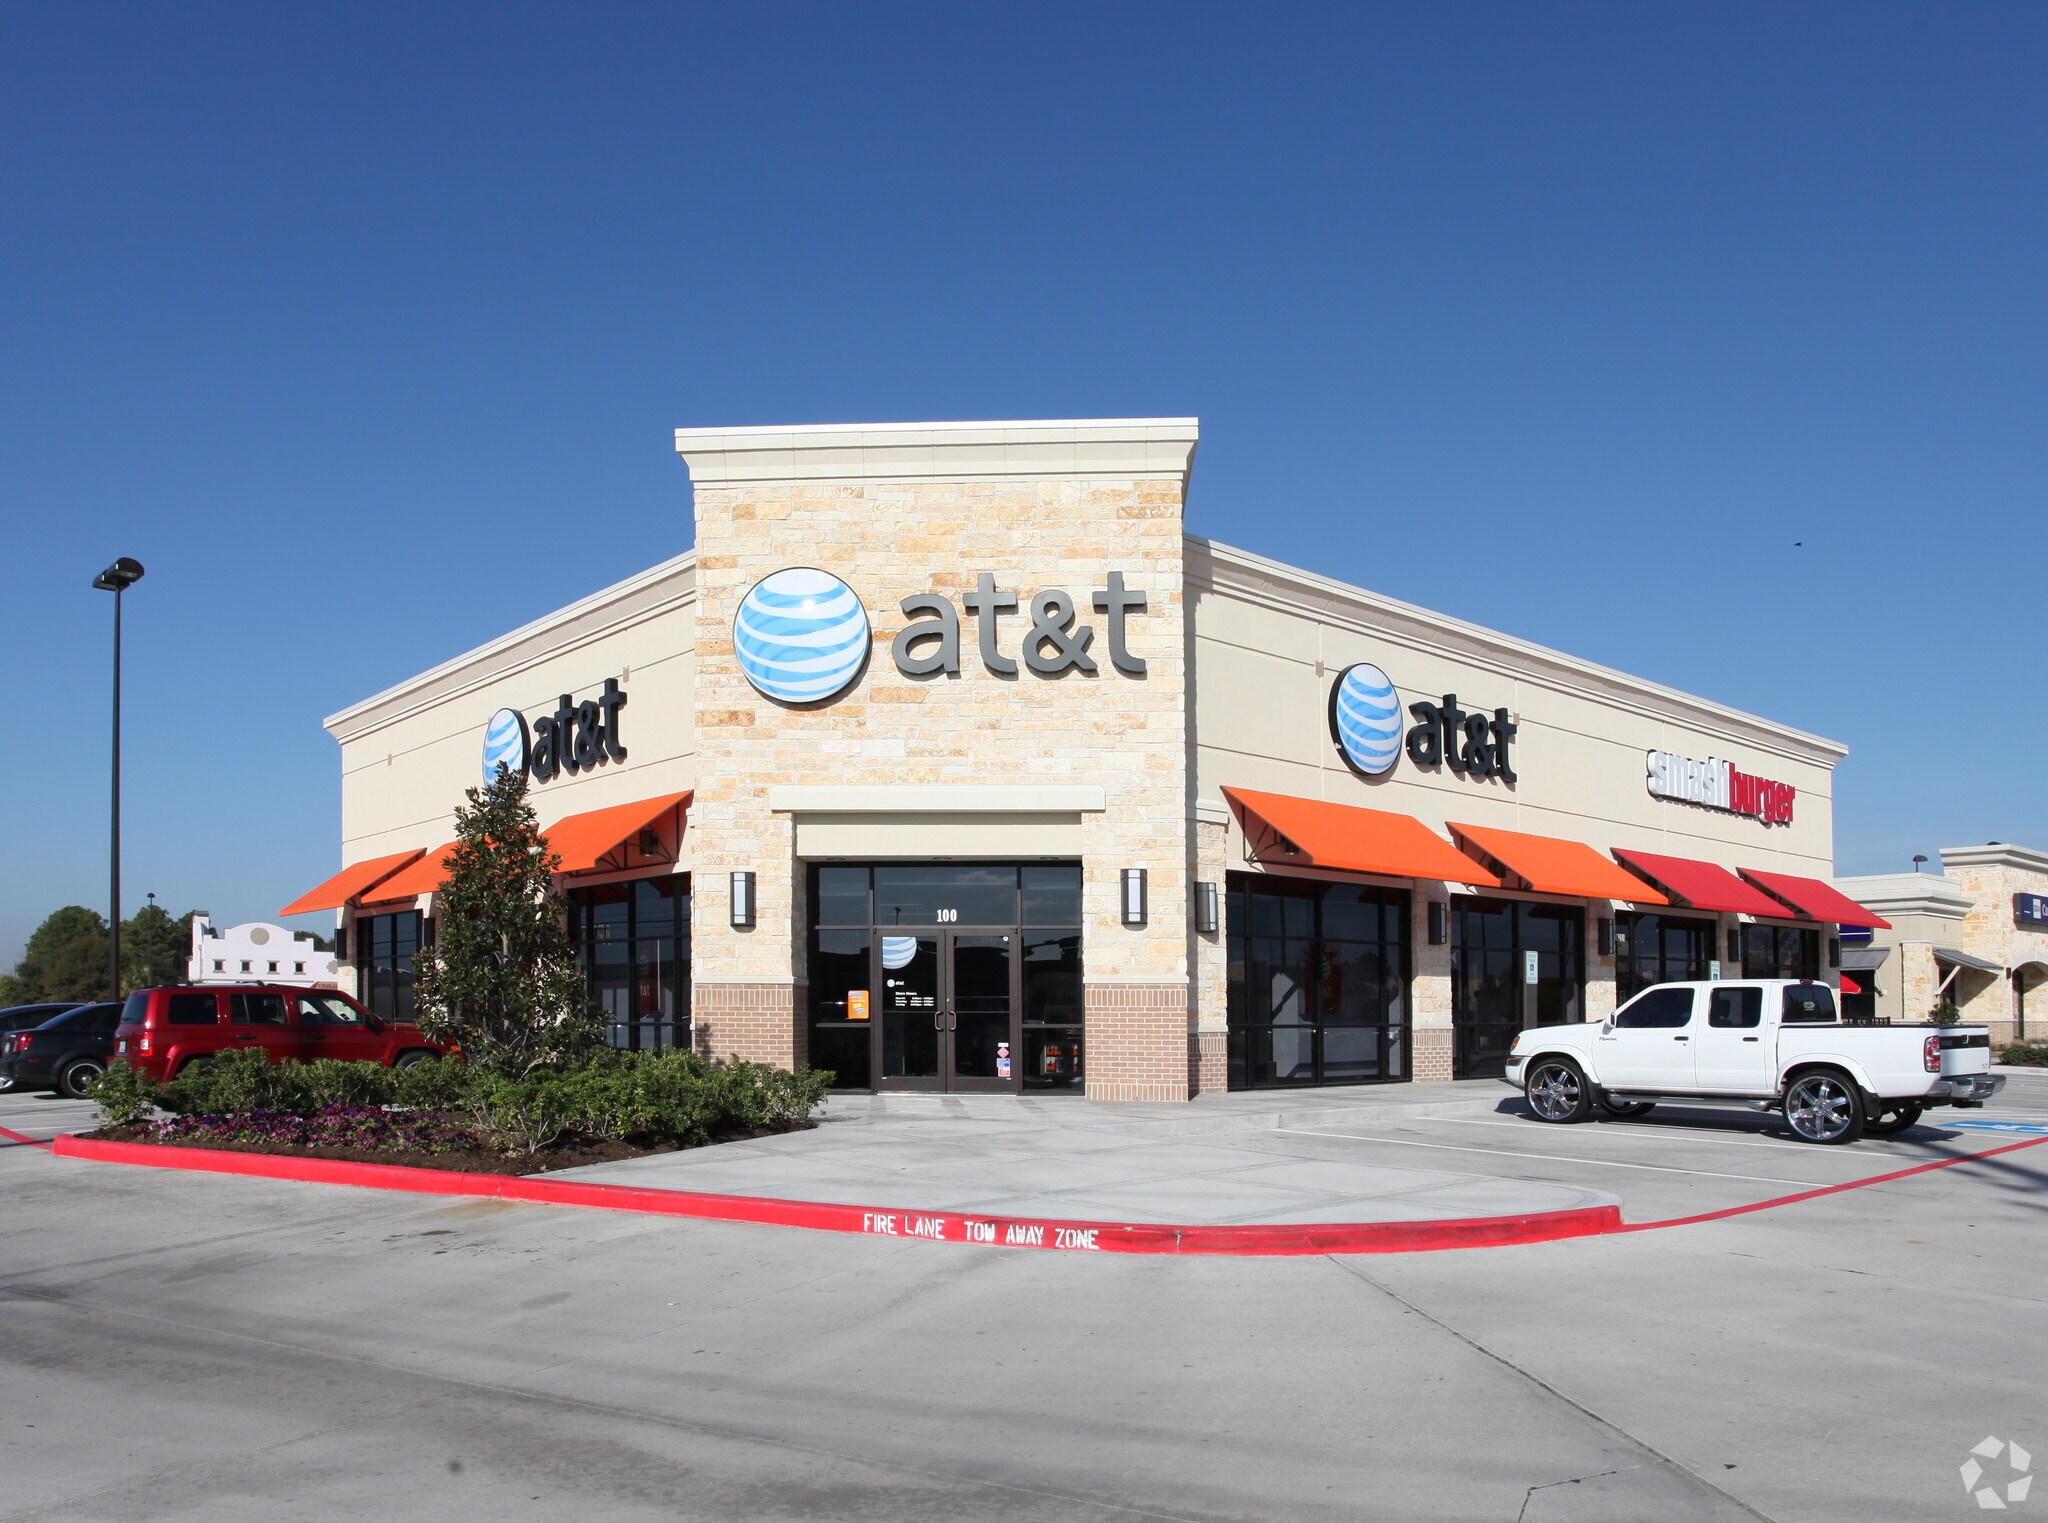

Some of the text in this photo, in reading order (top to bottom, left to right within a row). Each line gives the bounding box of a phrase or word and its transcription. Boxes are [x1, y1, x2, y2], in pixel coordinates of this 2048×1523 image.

[892, 571, 1146, 676] at&t
[531, 678, 628, 779] at&t
[1406, 693, 1518, 783] at&t
[1647, 749, 1796, 823] smashburger
[936, 908, 957, 922] 100
[863, 1213, 1100, 1250] FIRE LANE TOW AWAY ZONE
